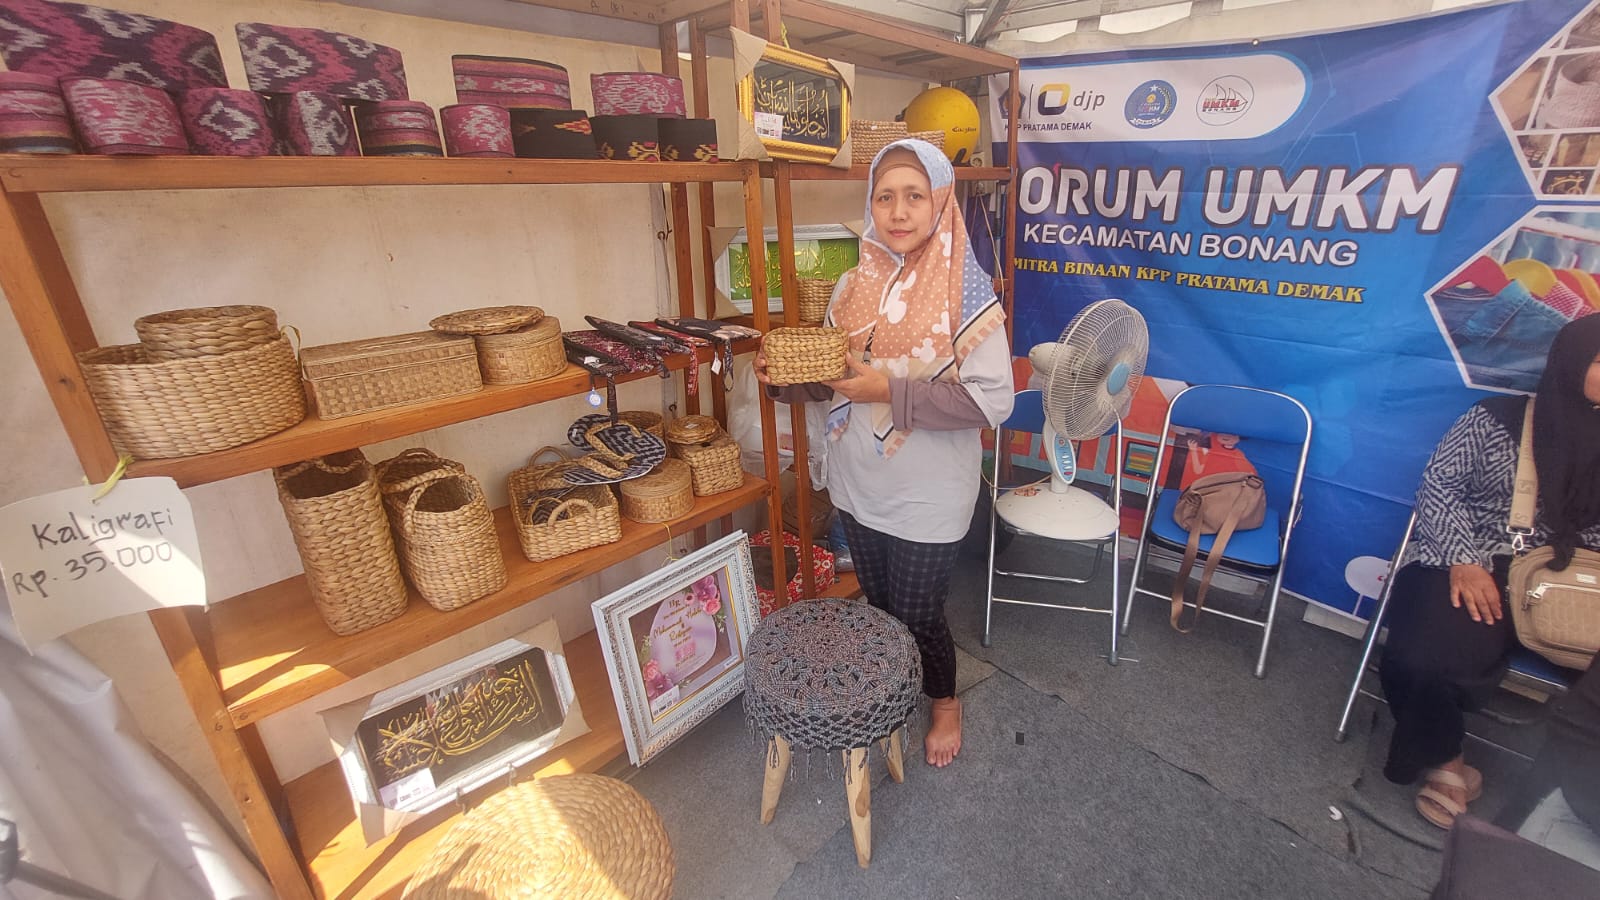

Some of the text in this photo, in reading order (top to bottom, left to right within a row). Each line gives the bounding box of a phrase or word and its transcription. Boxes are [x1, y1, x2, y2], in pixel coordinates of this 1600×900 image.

[1073, 90, 1105, 111] djp
[1023, 123, 1059, 131] PRATAMA
[1061, 121, 1093, 131] DEMAK
[1017, 165, 1459, 232] ORUM UMKM
[1023, 222, 1359, 267] KECAMATAN BONANG
[1063, 262, 1131, 280] BINAAN
[1135, 266, 1172, 282] KPP
[1176, 272, 1270, 295] PRATAMA
[1276, 281, 1366, 304] DEMAK
[12, 541, 173, 598] Rp. 35.000
